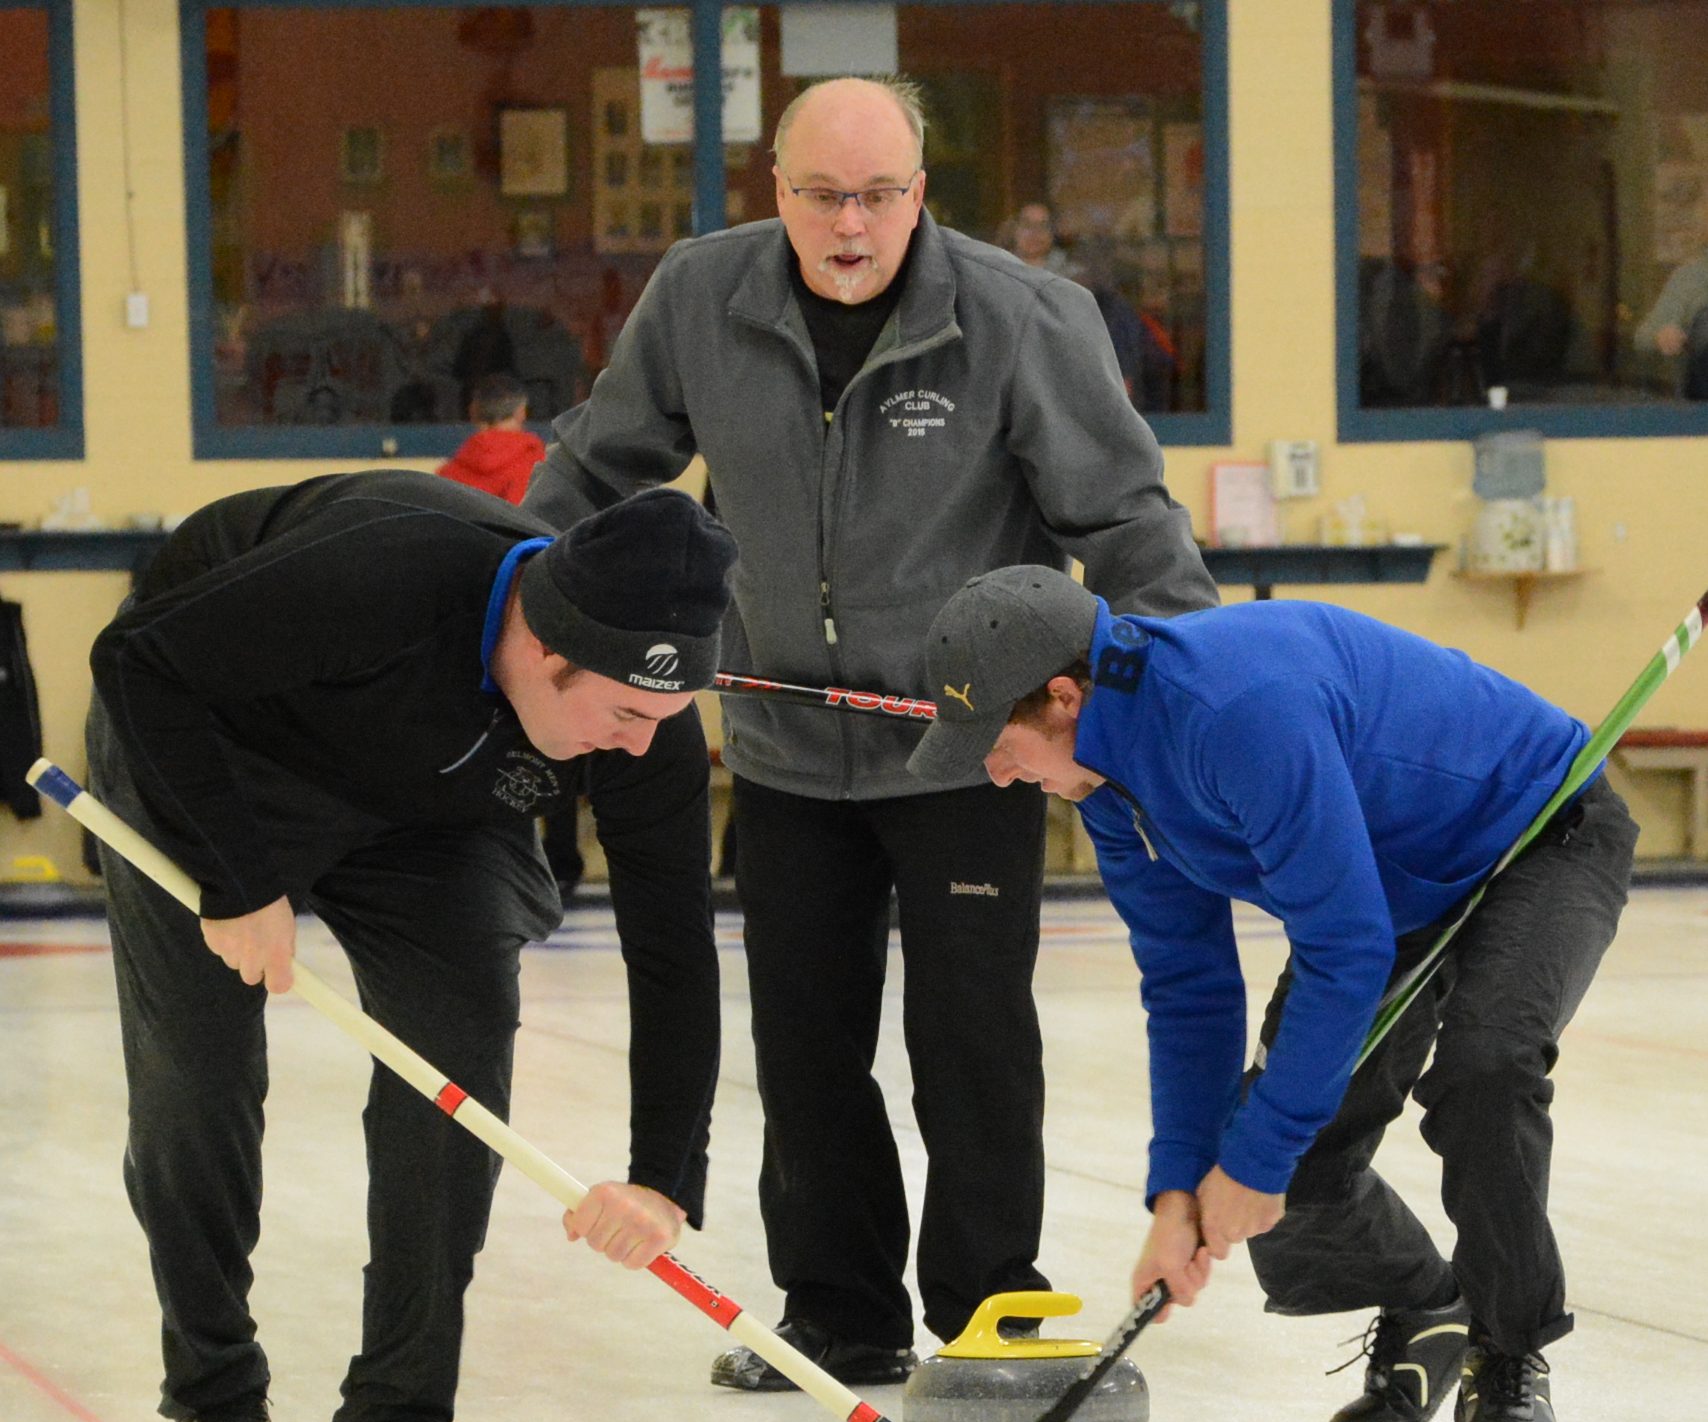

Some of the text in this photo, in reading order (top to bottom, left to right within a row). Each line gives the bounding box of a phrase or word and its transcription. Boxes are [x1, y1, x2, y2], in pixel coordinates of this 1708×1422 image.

[879, 389, 955, 414] AYLMER CURLING
[904, 401, 931, 411] CLUB
[902, 418, 946, 427] CHAMPIONS
[824, 686, 938, 720] TOUR
